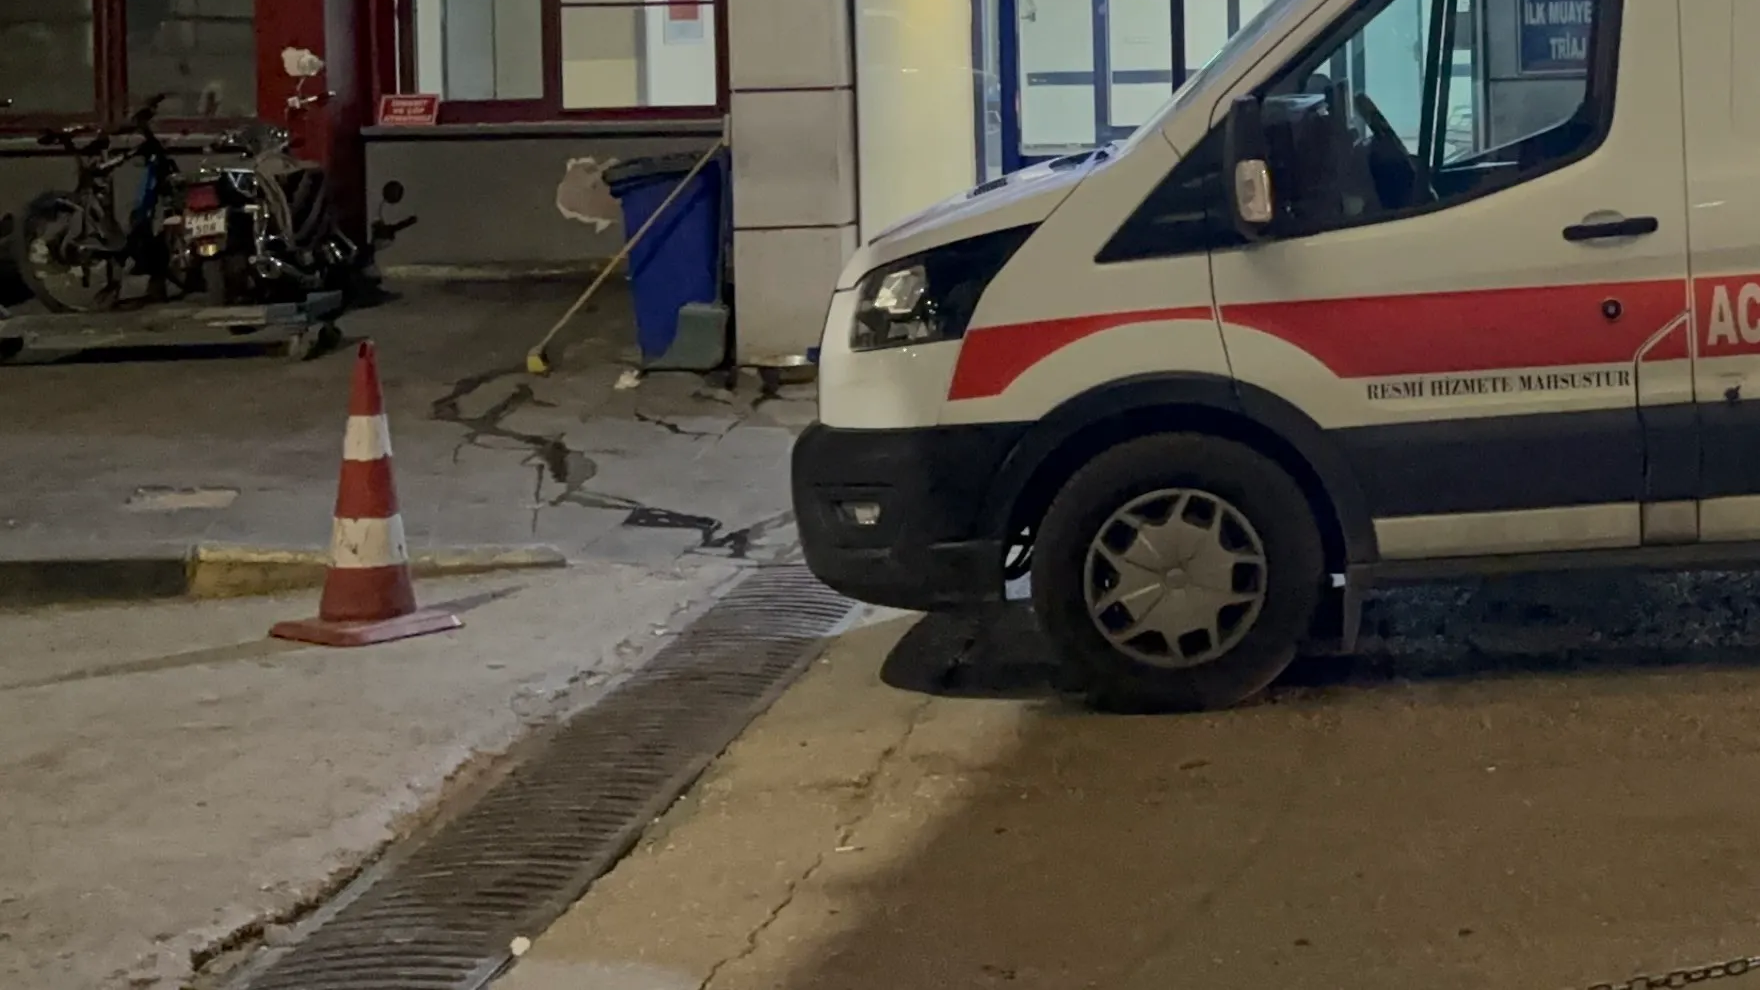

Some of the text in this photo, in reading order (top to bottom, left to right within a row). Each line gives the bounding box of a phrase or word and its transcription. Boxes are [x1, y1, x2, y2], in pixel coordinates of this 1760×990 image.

[1367, 370, 1631, 400] RESMİ HİZMETE MAHSUSTUR
